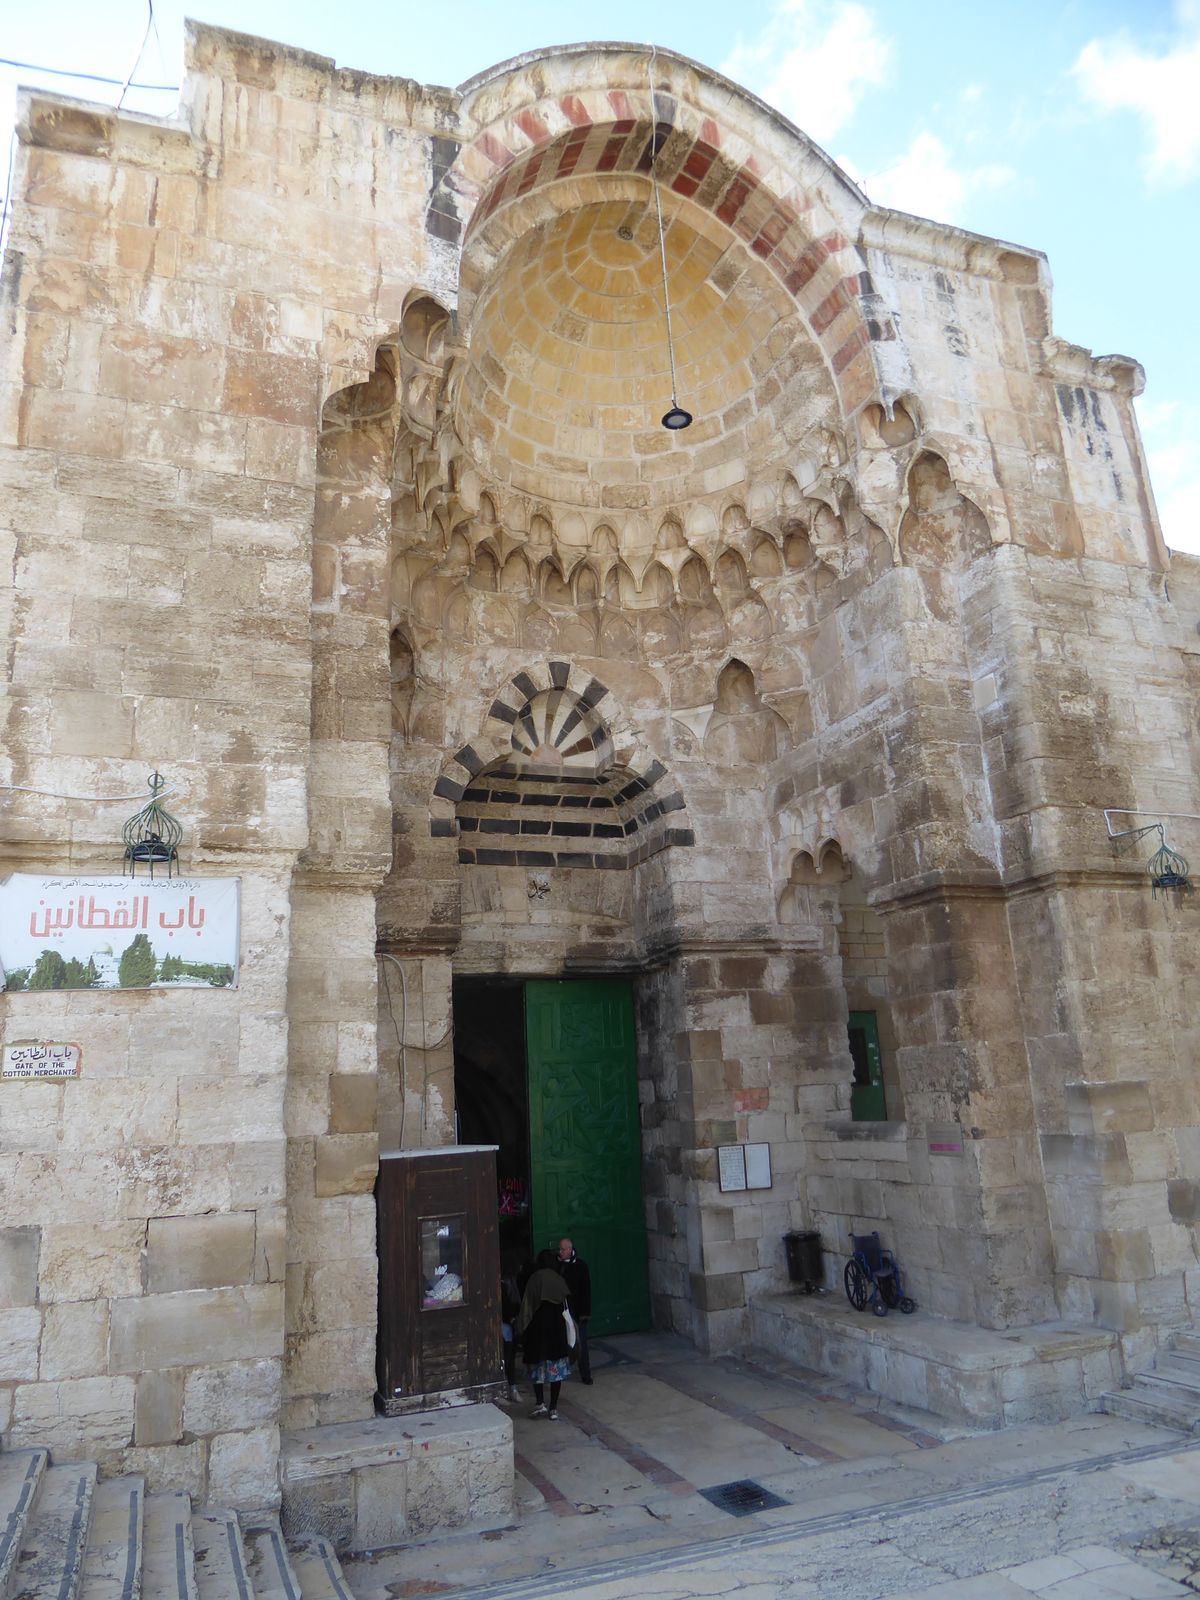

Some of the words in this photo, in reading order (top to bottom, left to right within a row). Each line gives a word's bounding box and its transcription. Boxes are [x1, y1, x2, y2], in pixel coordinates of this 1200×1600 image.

[30, 896, 149, 938] القطانين
[159, 896, 206, 937] باب
[10, 1046, 52, 1062] القطانين
[53, 1046, 72, 1061] باب
